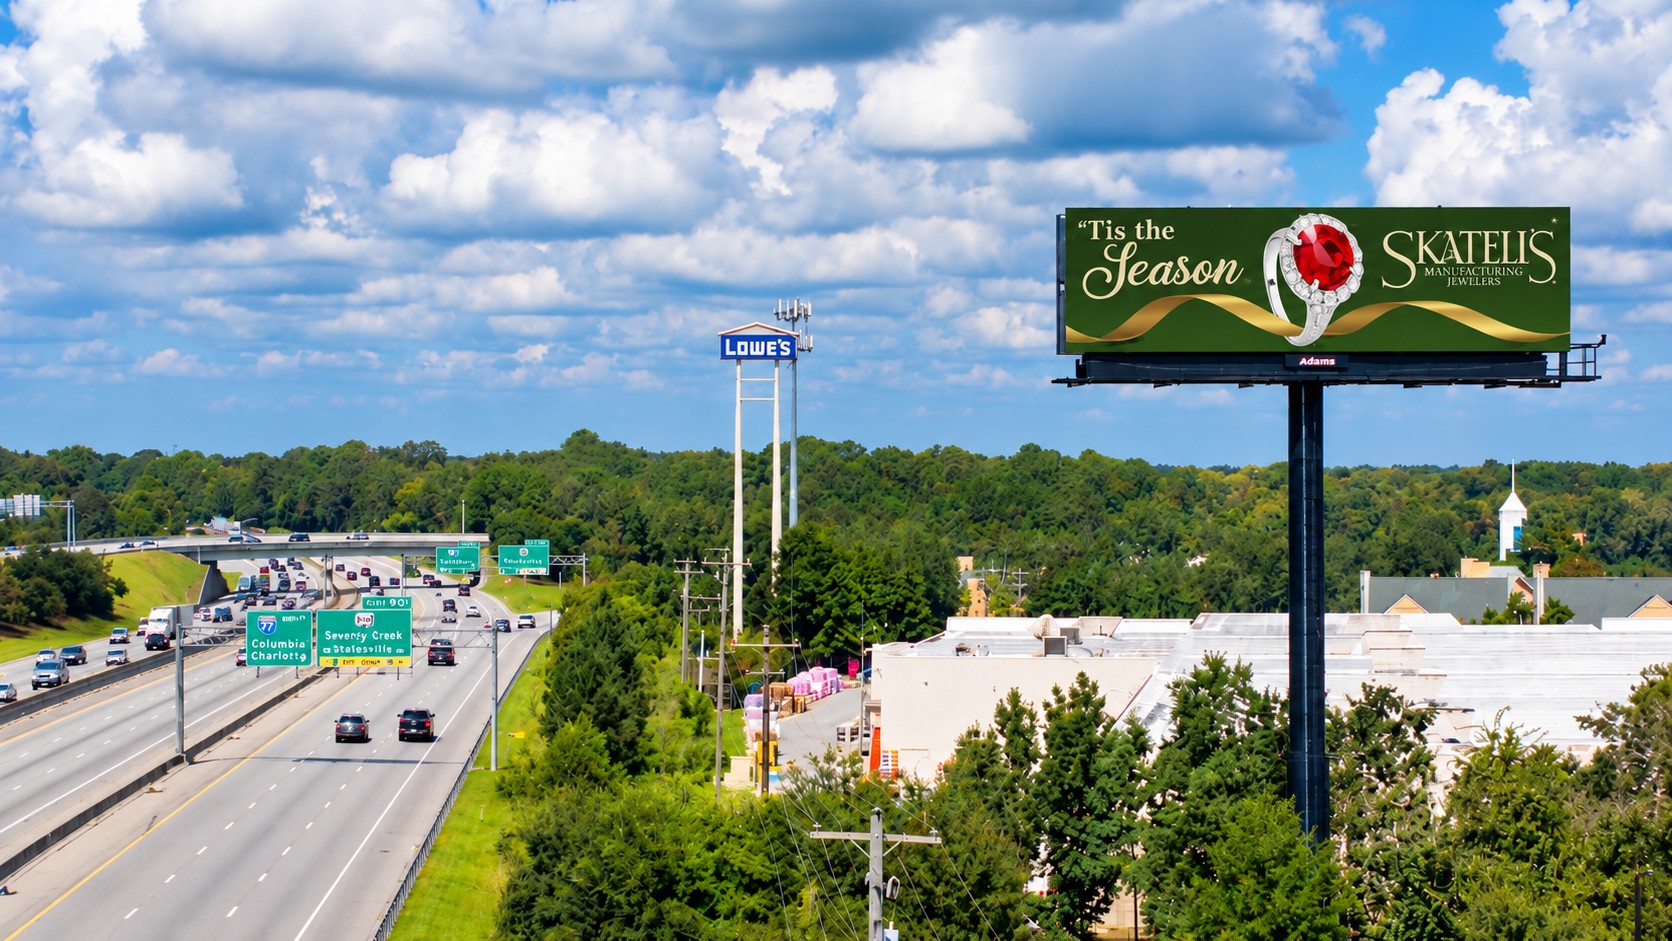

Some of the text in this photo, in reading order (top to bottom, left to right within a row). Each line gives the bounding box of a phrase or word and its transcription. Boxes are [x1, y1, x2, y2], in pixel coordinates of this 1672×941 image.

[1135, 219, 1175, 240] the
[1082, 241, 1244, 300] Season
[1424, 266, 1523, 277] MANUFACTURING
[1446, 277, 1501, 288] JEWELERS
[725, 338, 791, 356] LOWE'S
[1299, 356, 1336, 366] Adams
[260, 621, 274, 632] 77
[372, 630, 403, 641] Creek
[251, 638, 305, 649] Columbia
